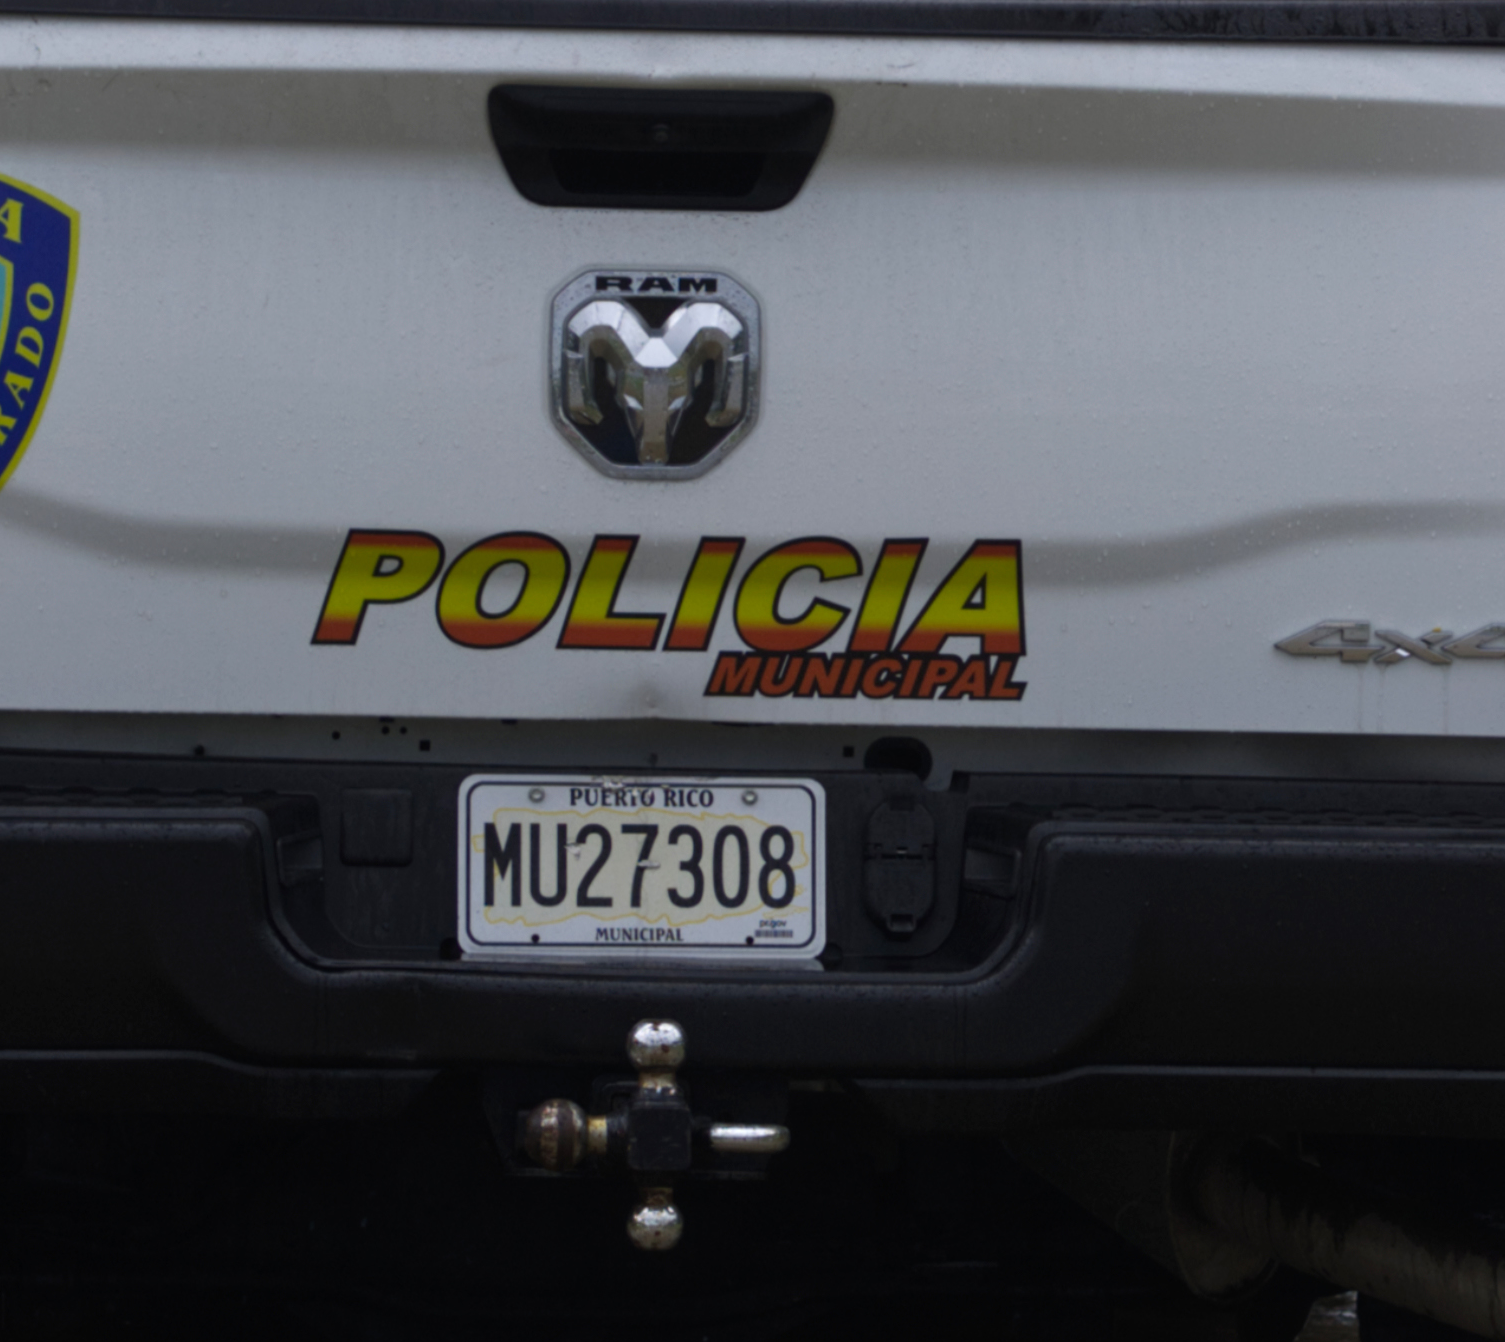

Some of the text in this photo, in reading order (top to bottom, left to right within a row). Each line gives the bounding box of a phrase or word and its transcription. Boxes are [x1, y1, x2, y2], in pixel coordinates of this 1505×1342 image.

[595, 275, 717, 293] RAM
[309, 528, 1027, 656] POLICIA
[703, 651, 1028, 702] MUNICIPAL
[569, 786, 714, 809] PUERTO RICO
[483, 821, 796, 909] MU27308
[595, 926, 685, 942] MUNICIPAL
